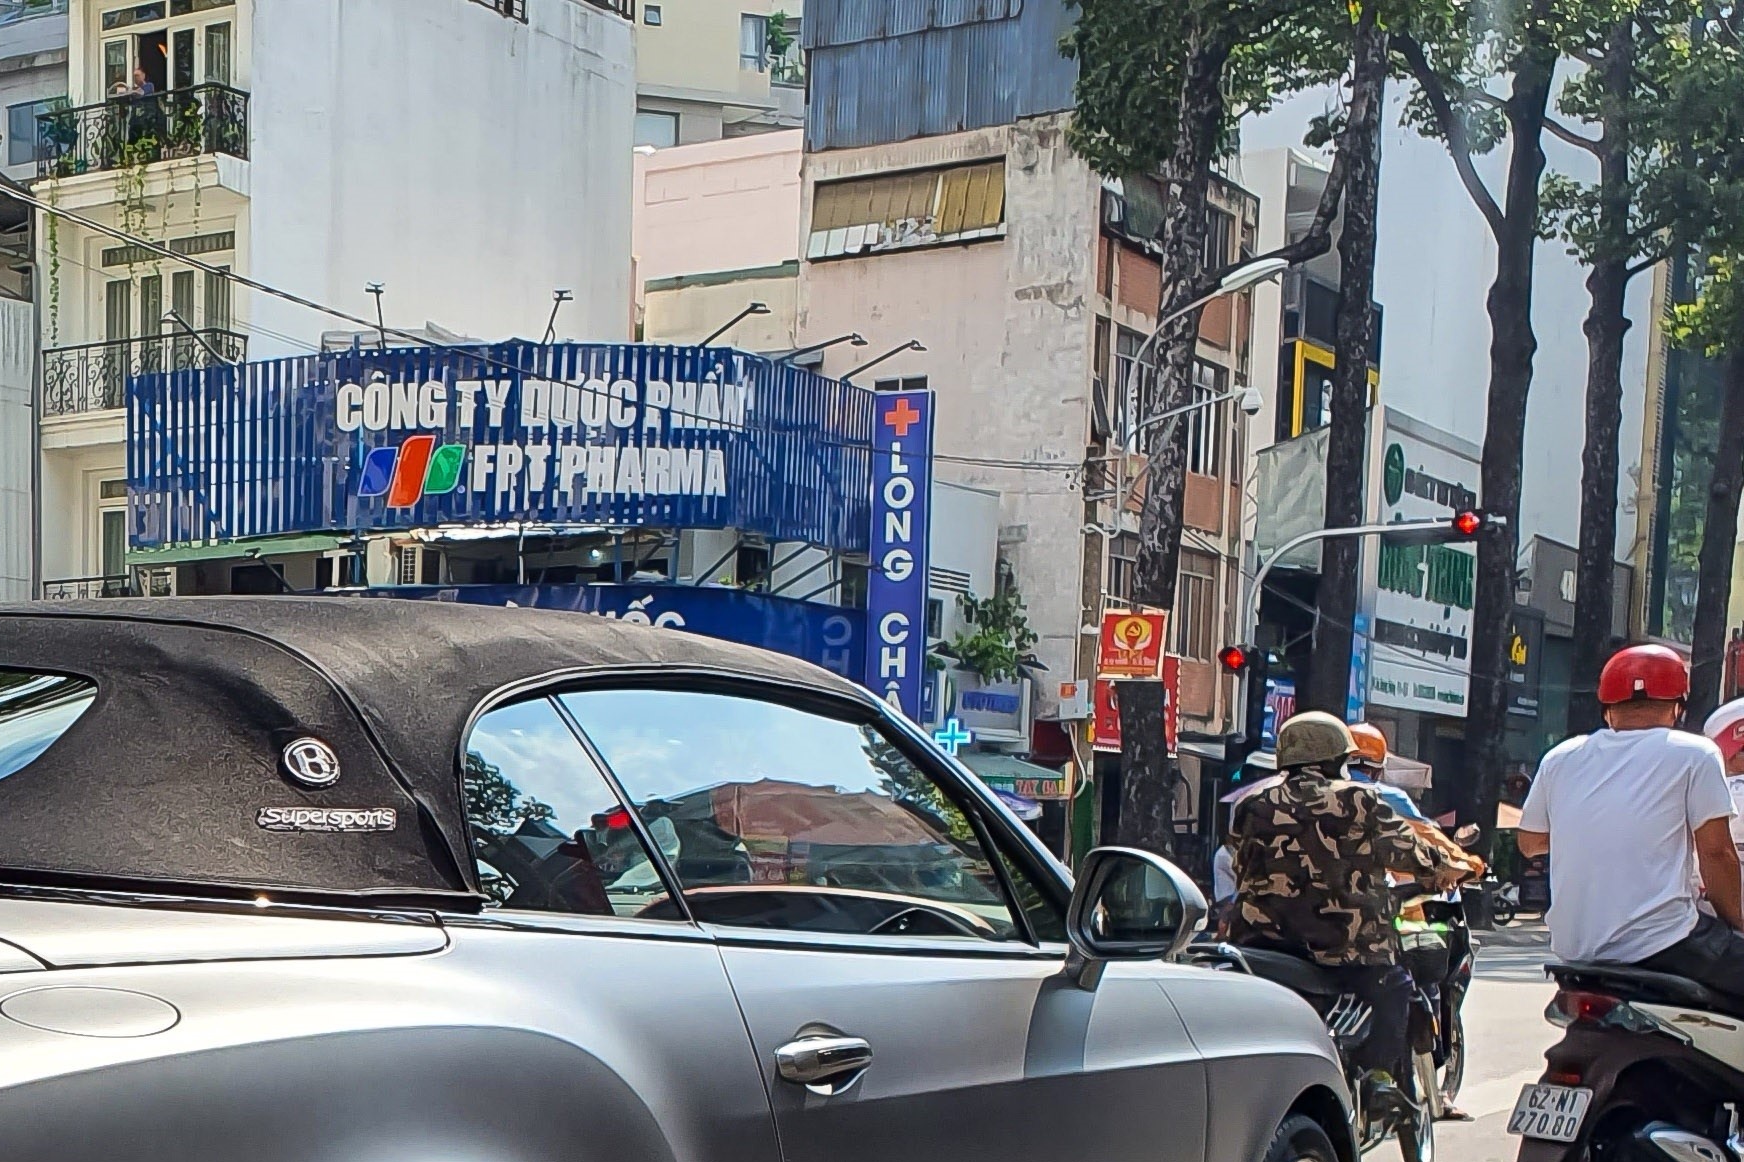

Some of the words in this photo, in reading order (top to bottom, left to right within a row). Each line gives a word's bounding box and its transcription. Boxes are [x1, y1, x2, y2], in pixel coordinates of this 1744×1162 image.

[336, 370, 448, 432] CÔNG
[455, 379, 513, 428] TY
[520, 371, 638, 438] DƯỢC
[645, 362, 746, 433] PHẨM
[558, 444, 727, 498] PHARMA
[881, 441, 915, 583] LONG
[262, 807, 395, 829] Supersports
